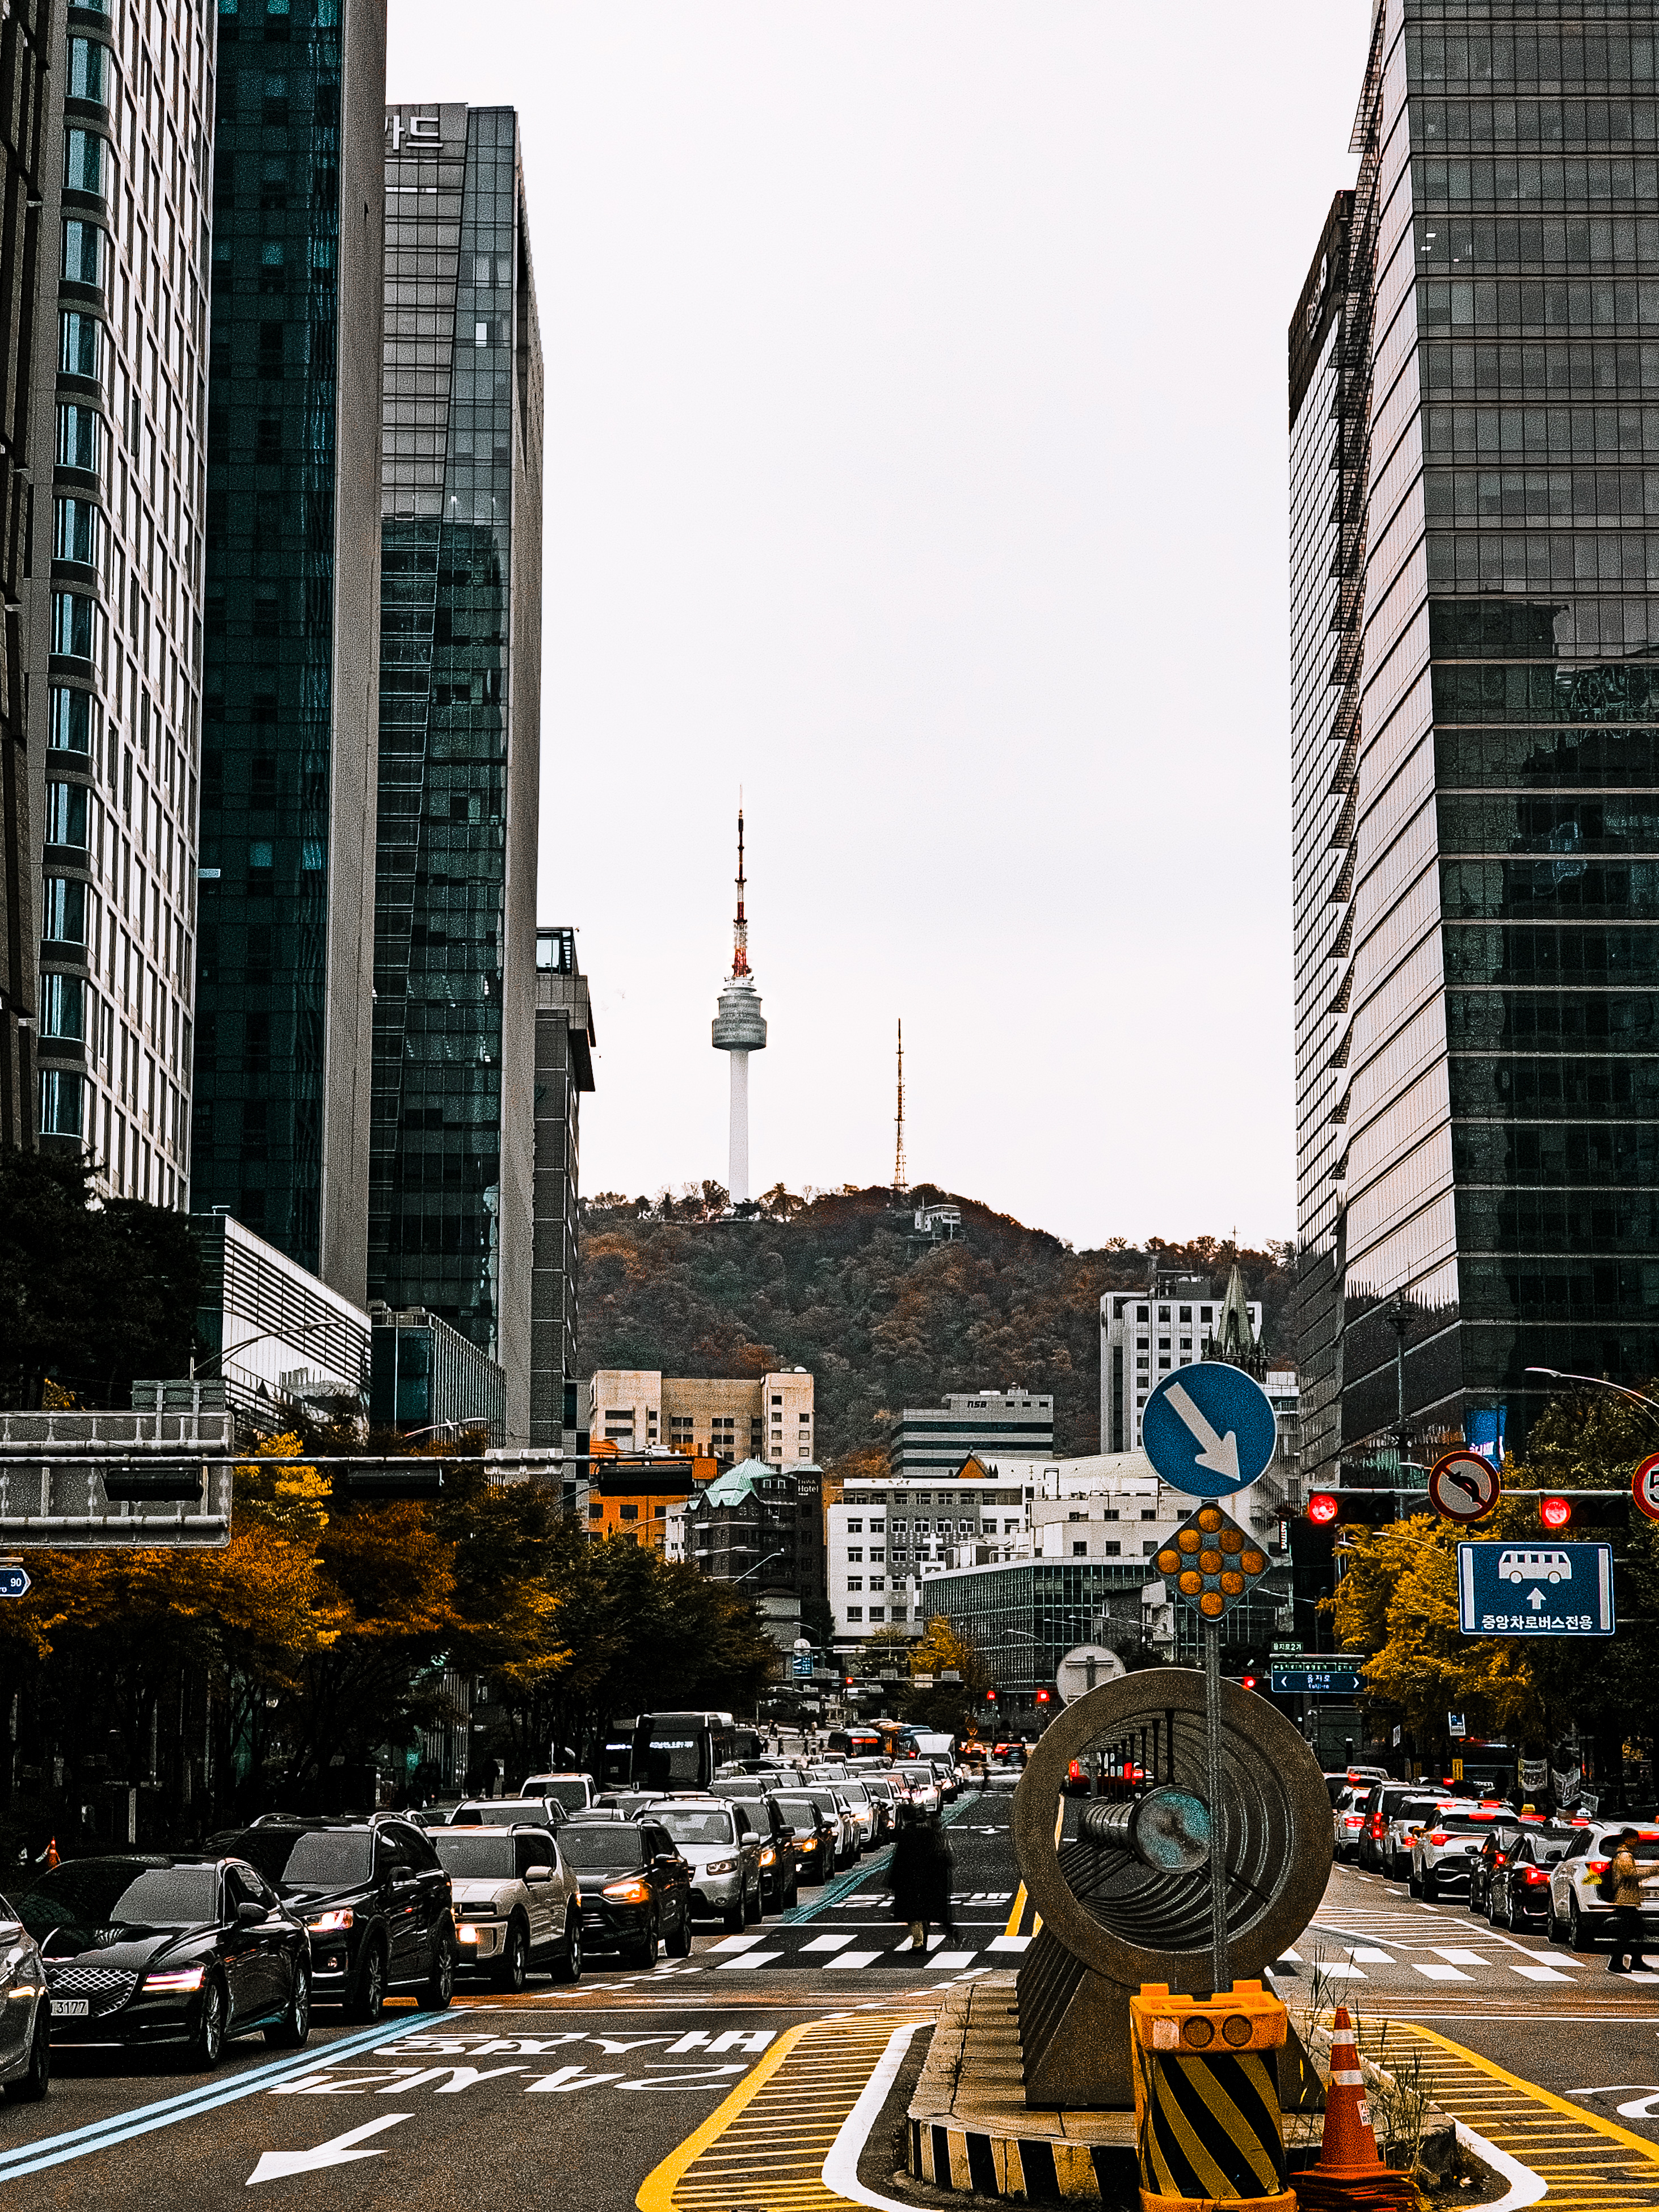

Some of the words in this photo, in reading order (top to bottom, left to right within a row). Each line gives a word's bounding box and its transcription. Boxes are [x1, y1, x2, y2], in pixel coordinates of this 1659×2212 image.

[10, 1577, 22, 1587] 90
[1481, 1615, 1593, 1629] 중앙차로버스전용
[57, 2001, 86, 2014] 3177
[372, 2030, 777, 2056] 버스전용
[267, 2064, 749, 2094] 24시간
